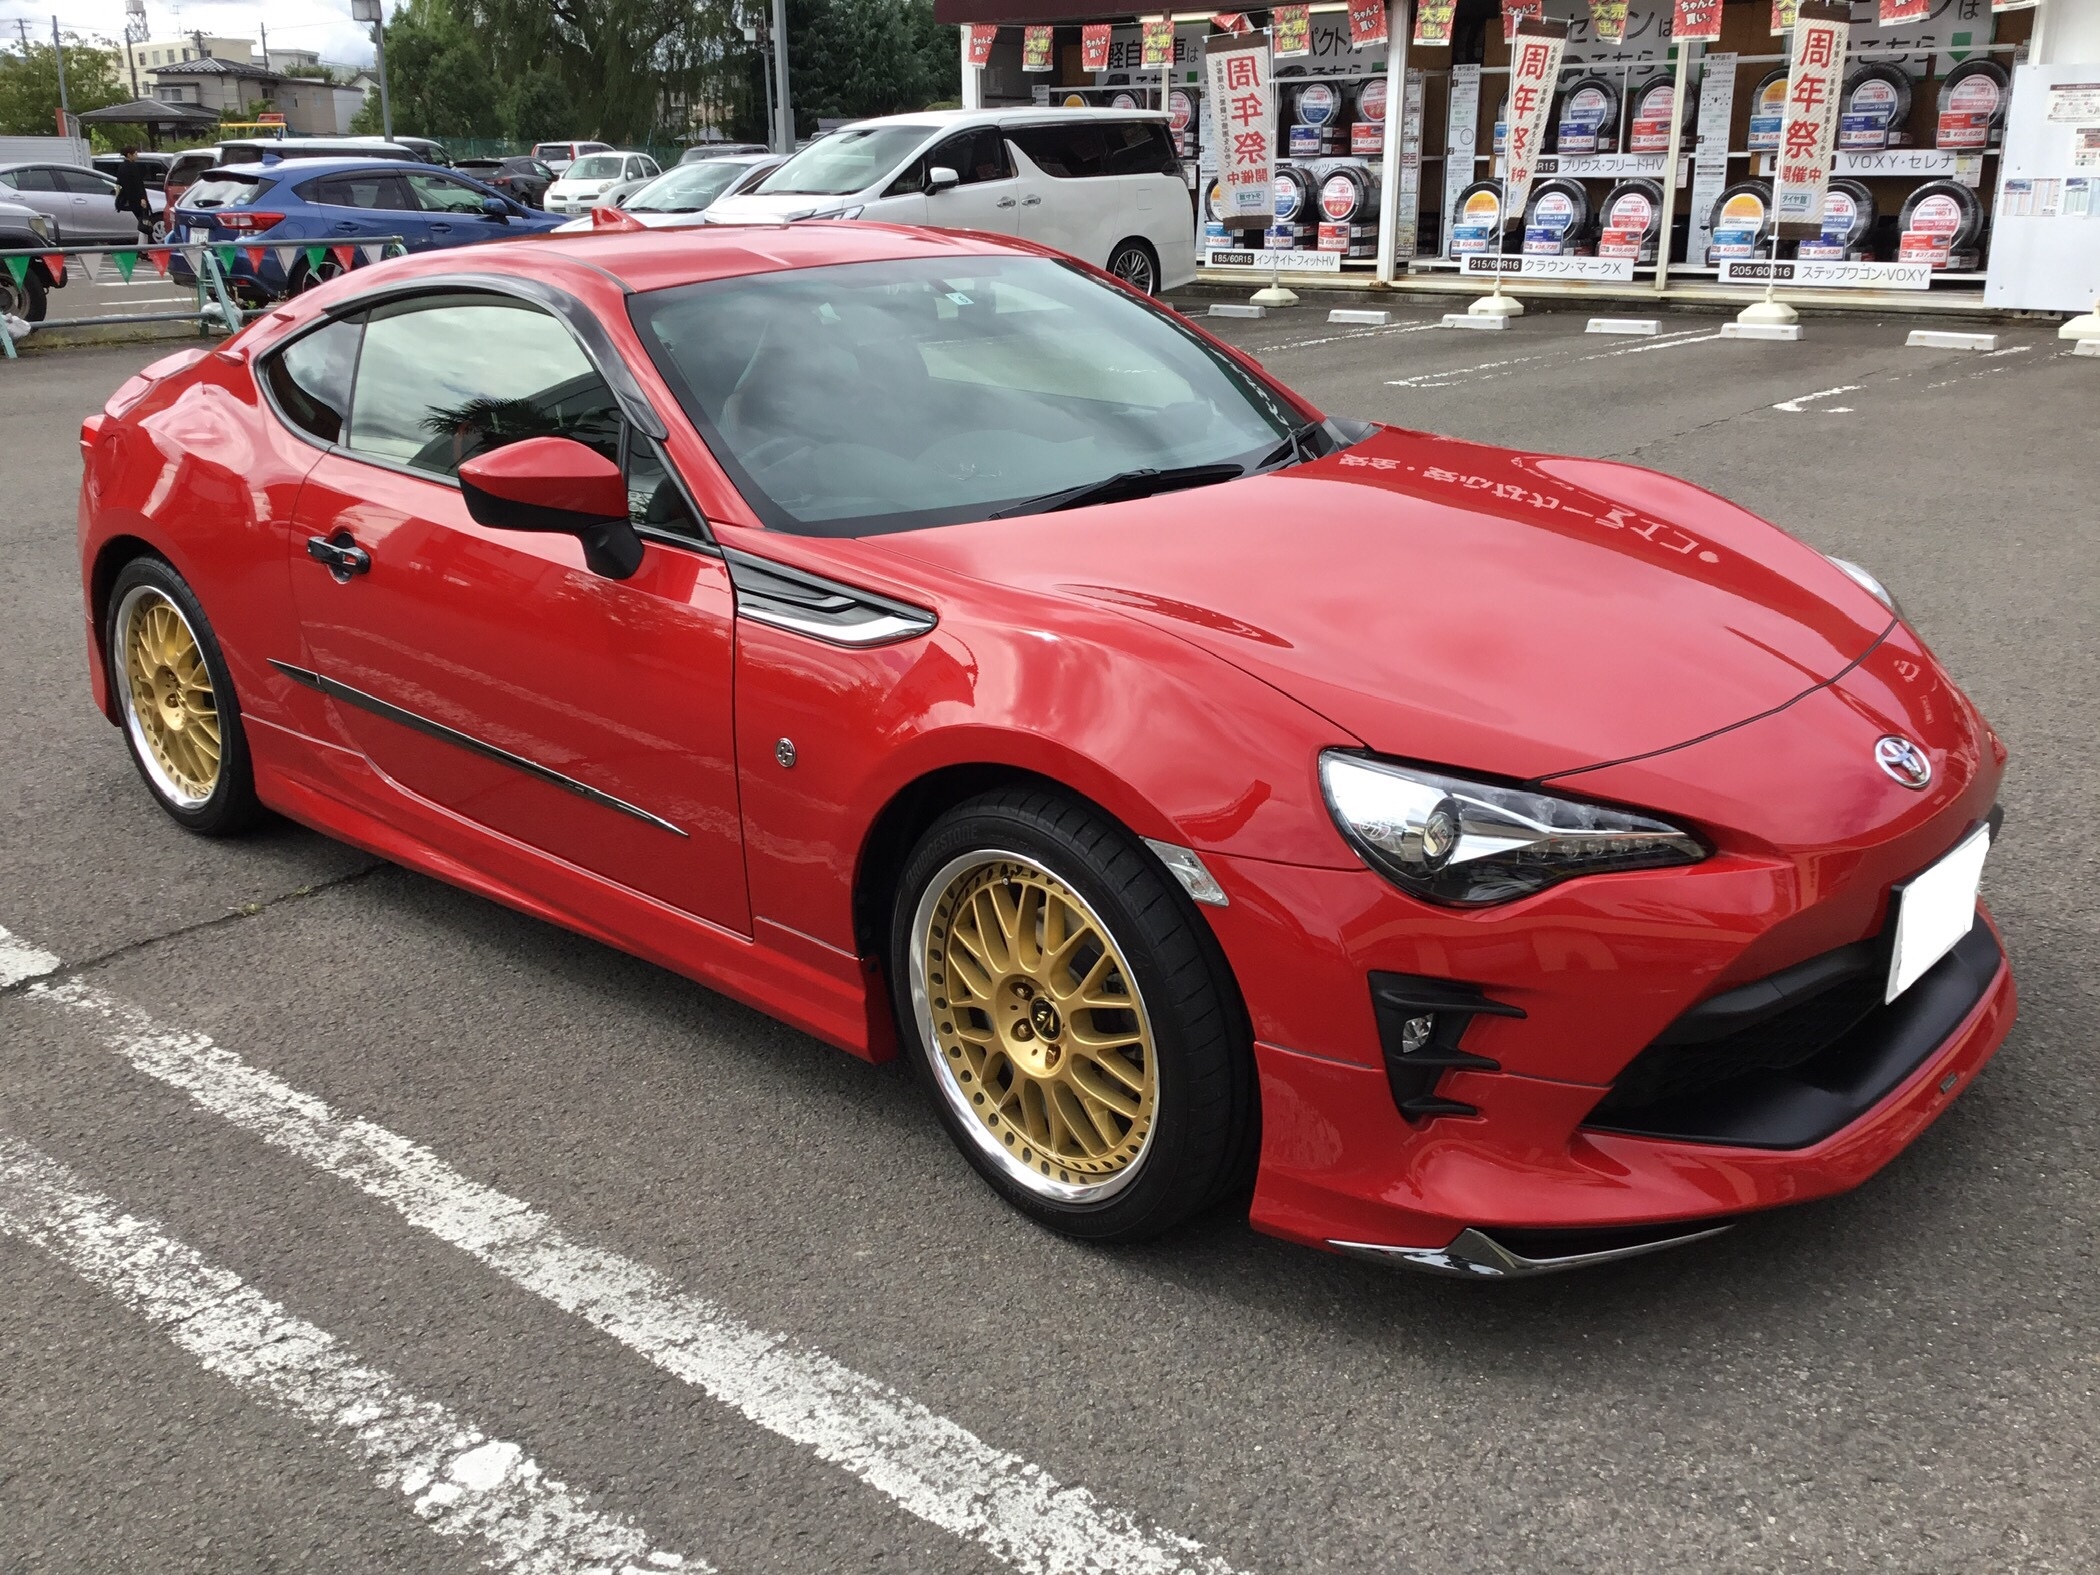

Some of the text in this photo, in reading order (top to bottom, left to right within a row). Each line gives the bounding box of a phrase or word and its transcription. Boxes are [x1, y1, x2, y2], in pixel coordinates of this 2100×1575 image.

[1353, 4, 1379, 21] ちゃんと
[1420, 6, 1453, 22] 大売
[1590, 3, 1628, 20] 大売
[1686, 12, 1712, 26] 買い。
[1279, 19, 1308, 35] 大売
[1422, 23, 1446, 38] 出し
[1598, 20, 1621, 36] 出し
[1085, 36, 1106, 48] ちゃんと
[1145, 34, 1172, 48] 大売
[1282, 37, 1304, 51] 出し
[1147, 49, 1168, 62] 出し
[1785, 28, 1835, 160] 周年祭
[1561, 158, 1665, 173] プリウス・フリードHV
[1848, 155, 1955, 169] VOXY・セレナ
[1781, 166, 1823, 185] 開催中
[1213, 254, 1253, 264] 185/60R15
[1523, 259, 1622, 275] クラウン・マークX
[1802, 266, 1928, 282] ステップワゴン・VOXY
